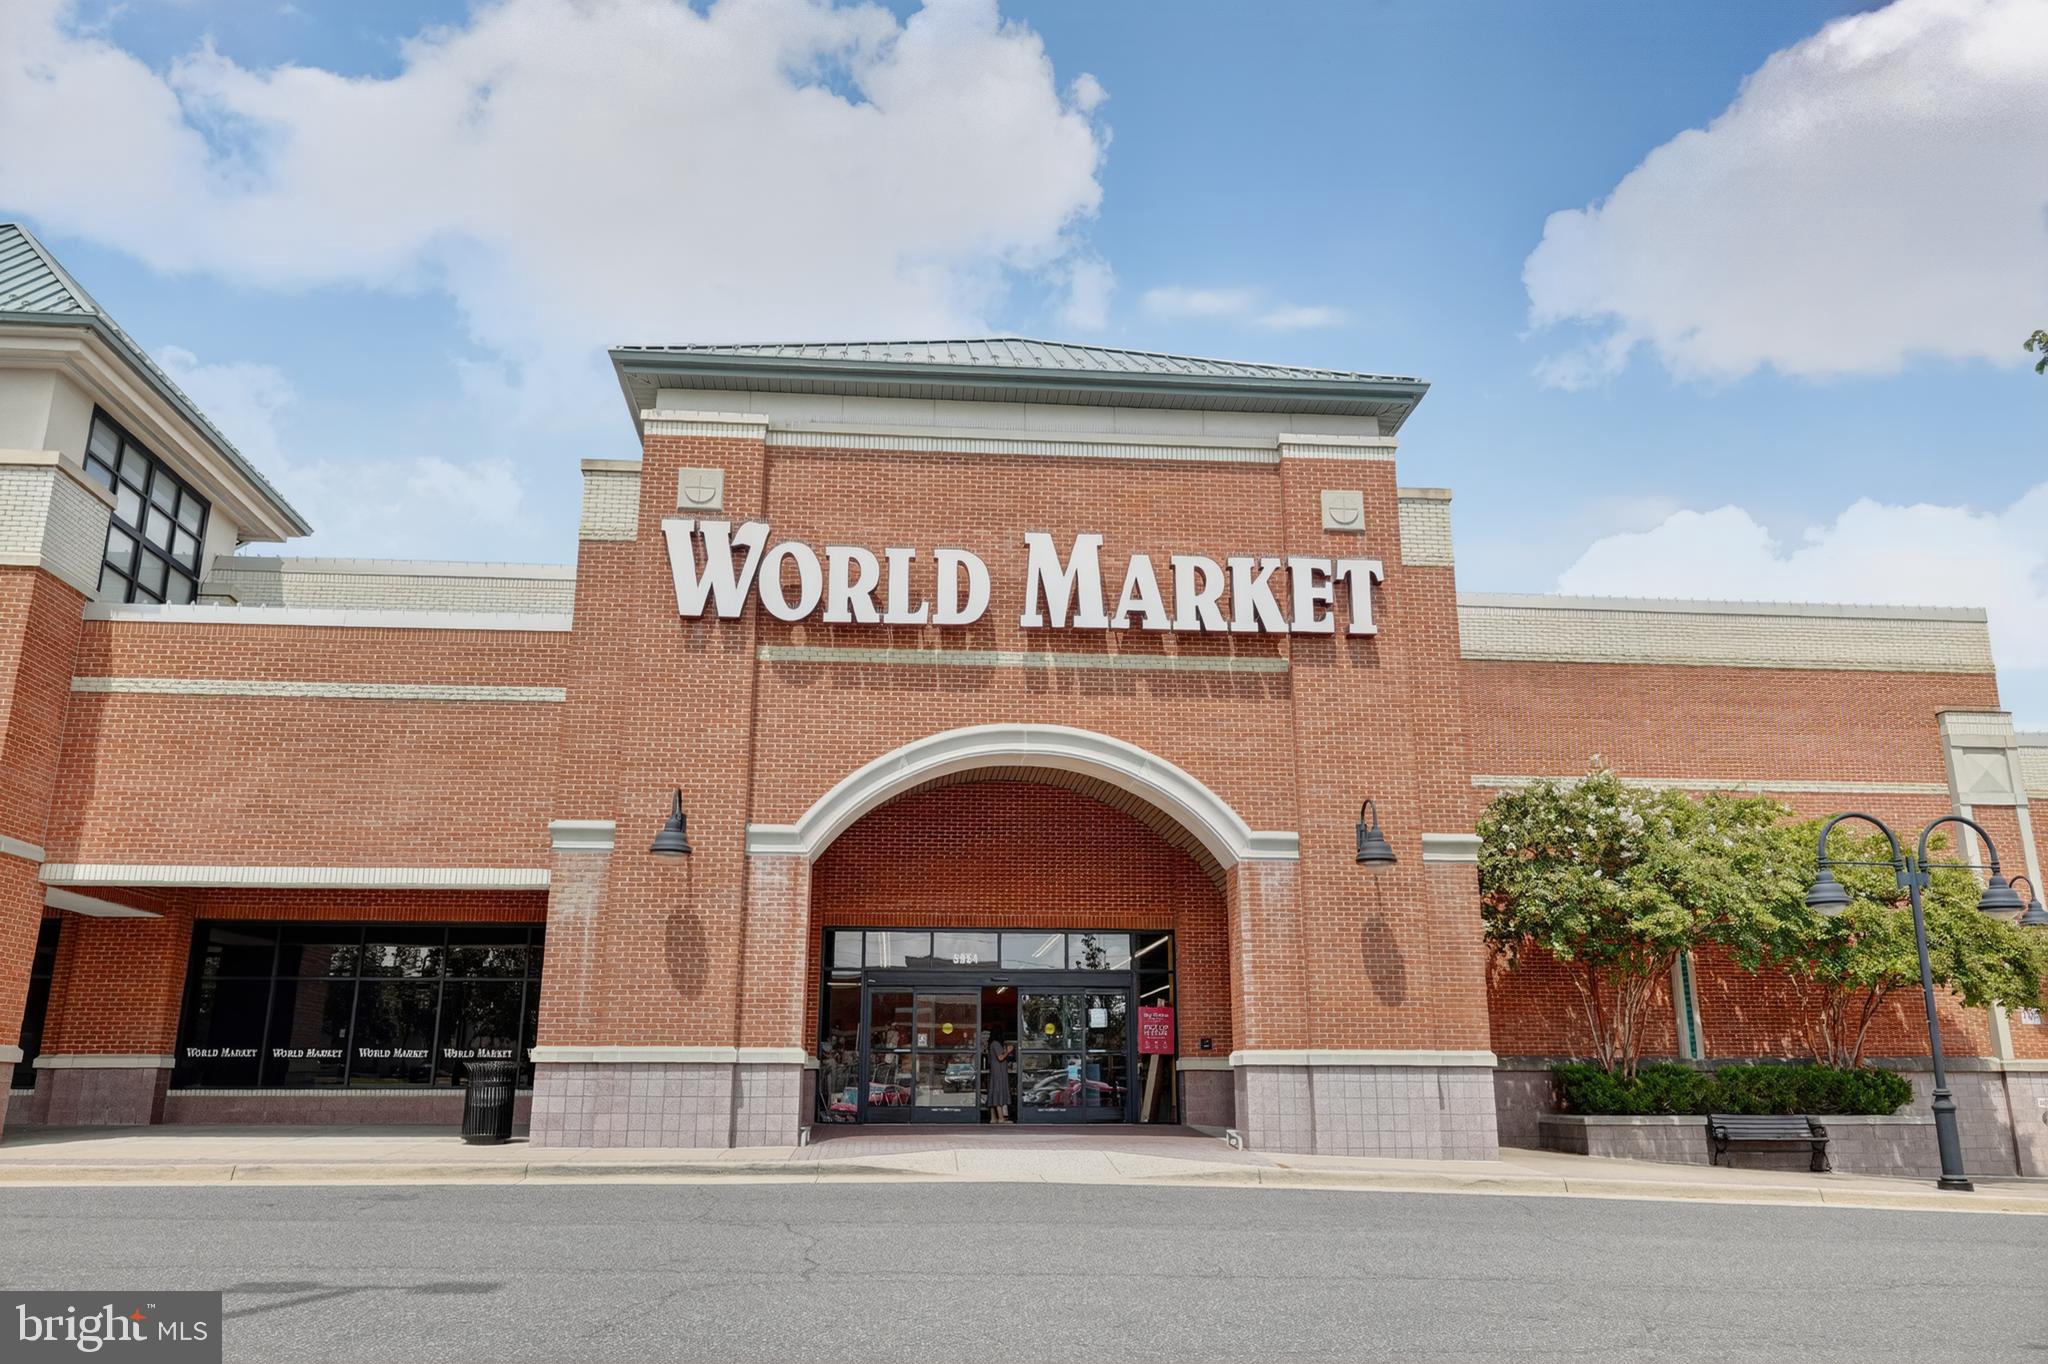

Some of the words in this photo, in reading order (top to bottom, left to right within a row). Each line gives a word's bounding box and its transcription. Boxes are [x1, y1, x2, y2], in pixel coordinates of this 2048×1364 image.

[661, 519, 991, 625] WORLD
[1020, 532, 1384, 635] MARKET
[186, 1047, 219, 1058] WORLD
[272, 1048, 304, 1058] WORLD
[358, 1047, 391, 1058] WORLD
